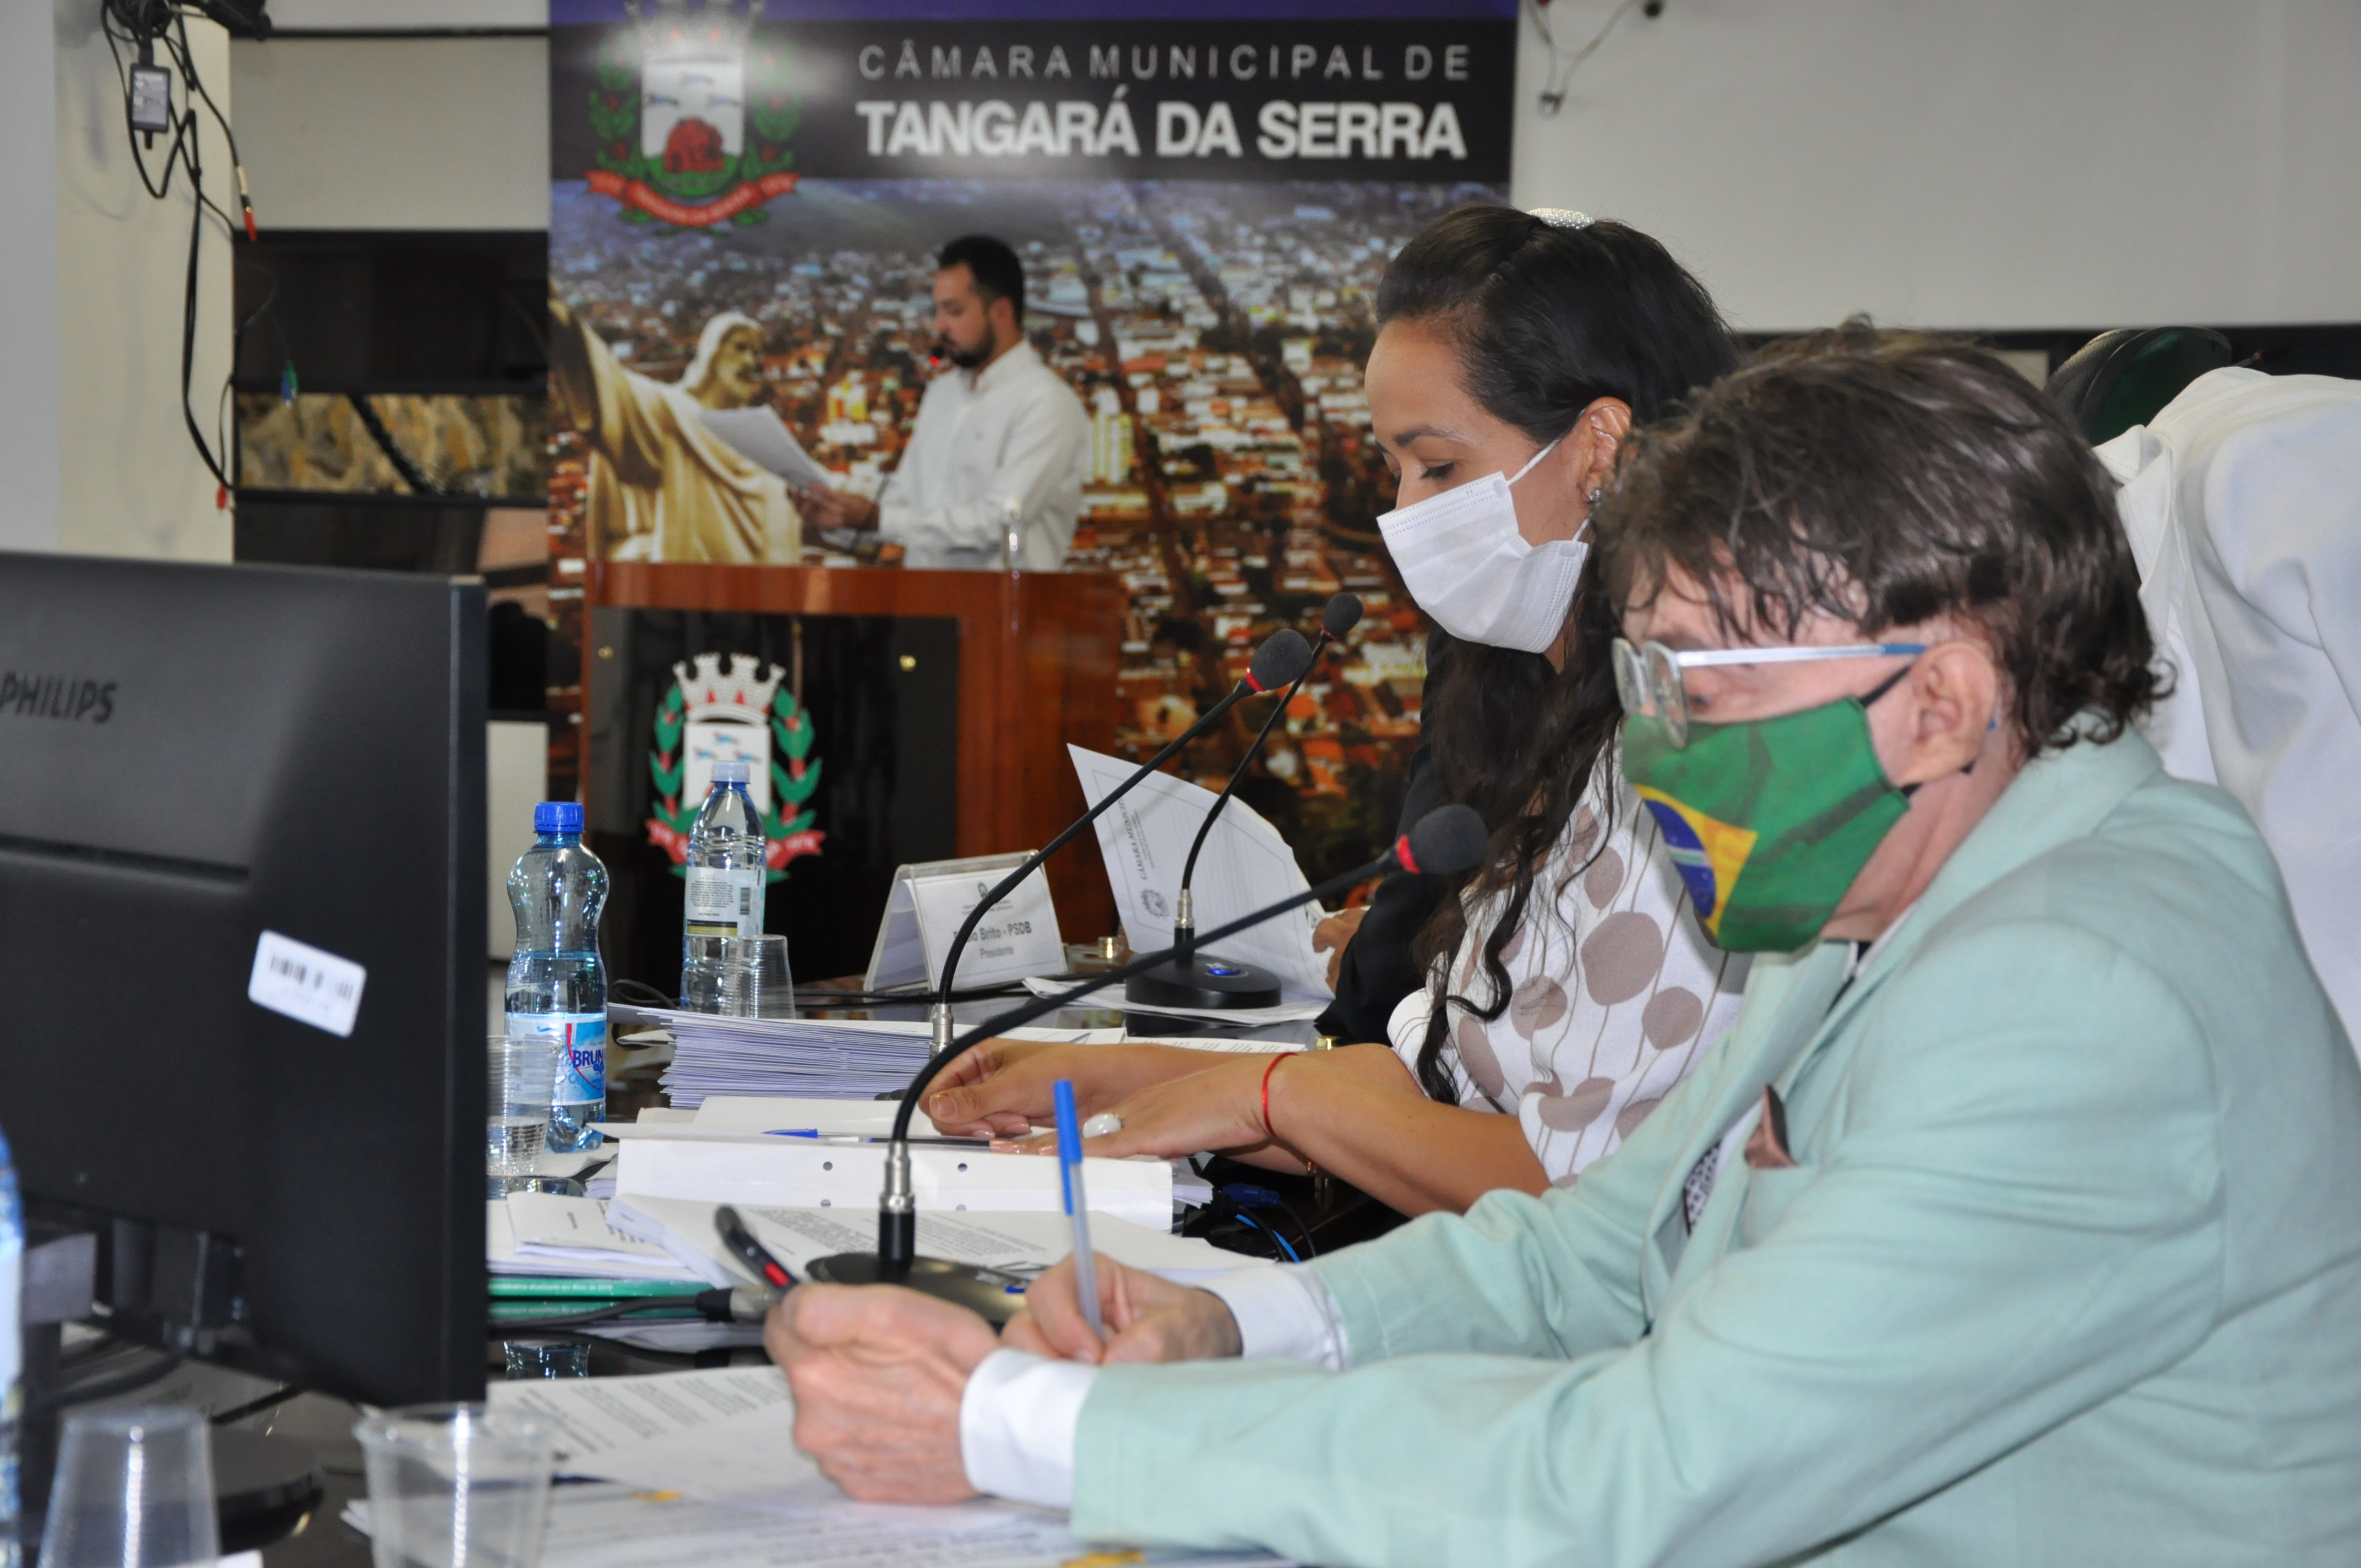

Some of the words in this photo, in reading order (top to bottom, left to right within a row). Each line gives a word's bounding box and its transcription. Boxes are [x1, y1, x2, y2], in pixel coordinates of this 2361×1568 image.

[858, 38, 1071, 80] CÂMARA
[1089, 44, 1383, 80] MUNICIPAL
[1405, 44, 1470, 80] DE
[855, 83, 1141, 157] TANGARÁ
[1156, 101, 1243, 158] DA
[1256, 99, 1468, 159] SERRA
[0, 671, 118, 724] PHILIPS
[980, 927, 1001, 940] Brito
[1008, 921, 1032, 935] PSDB
[573, 1048, 605, 1068] BRUN
